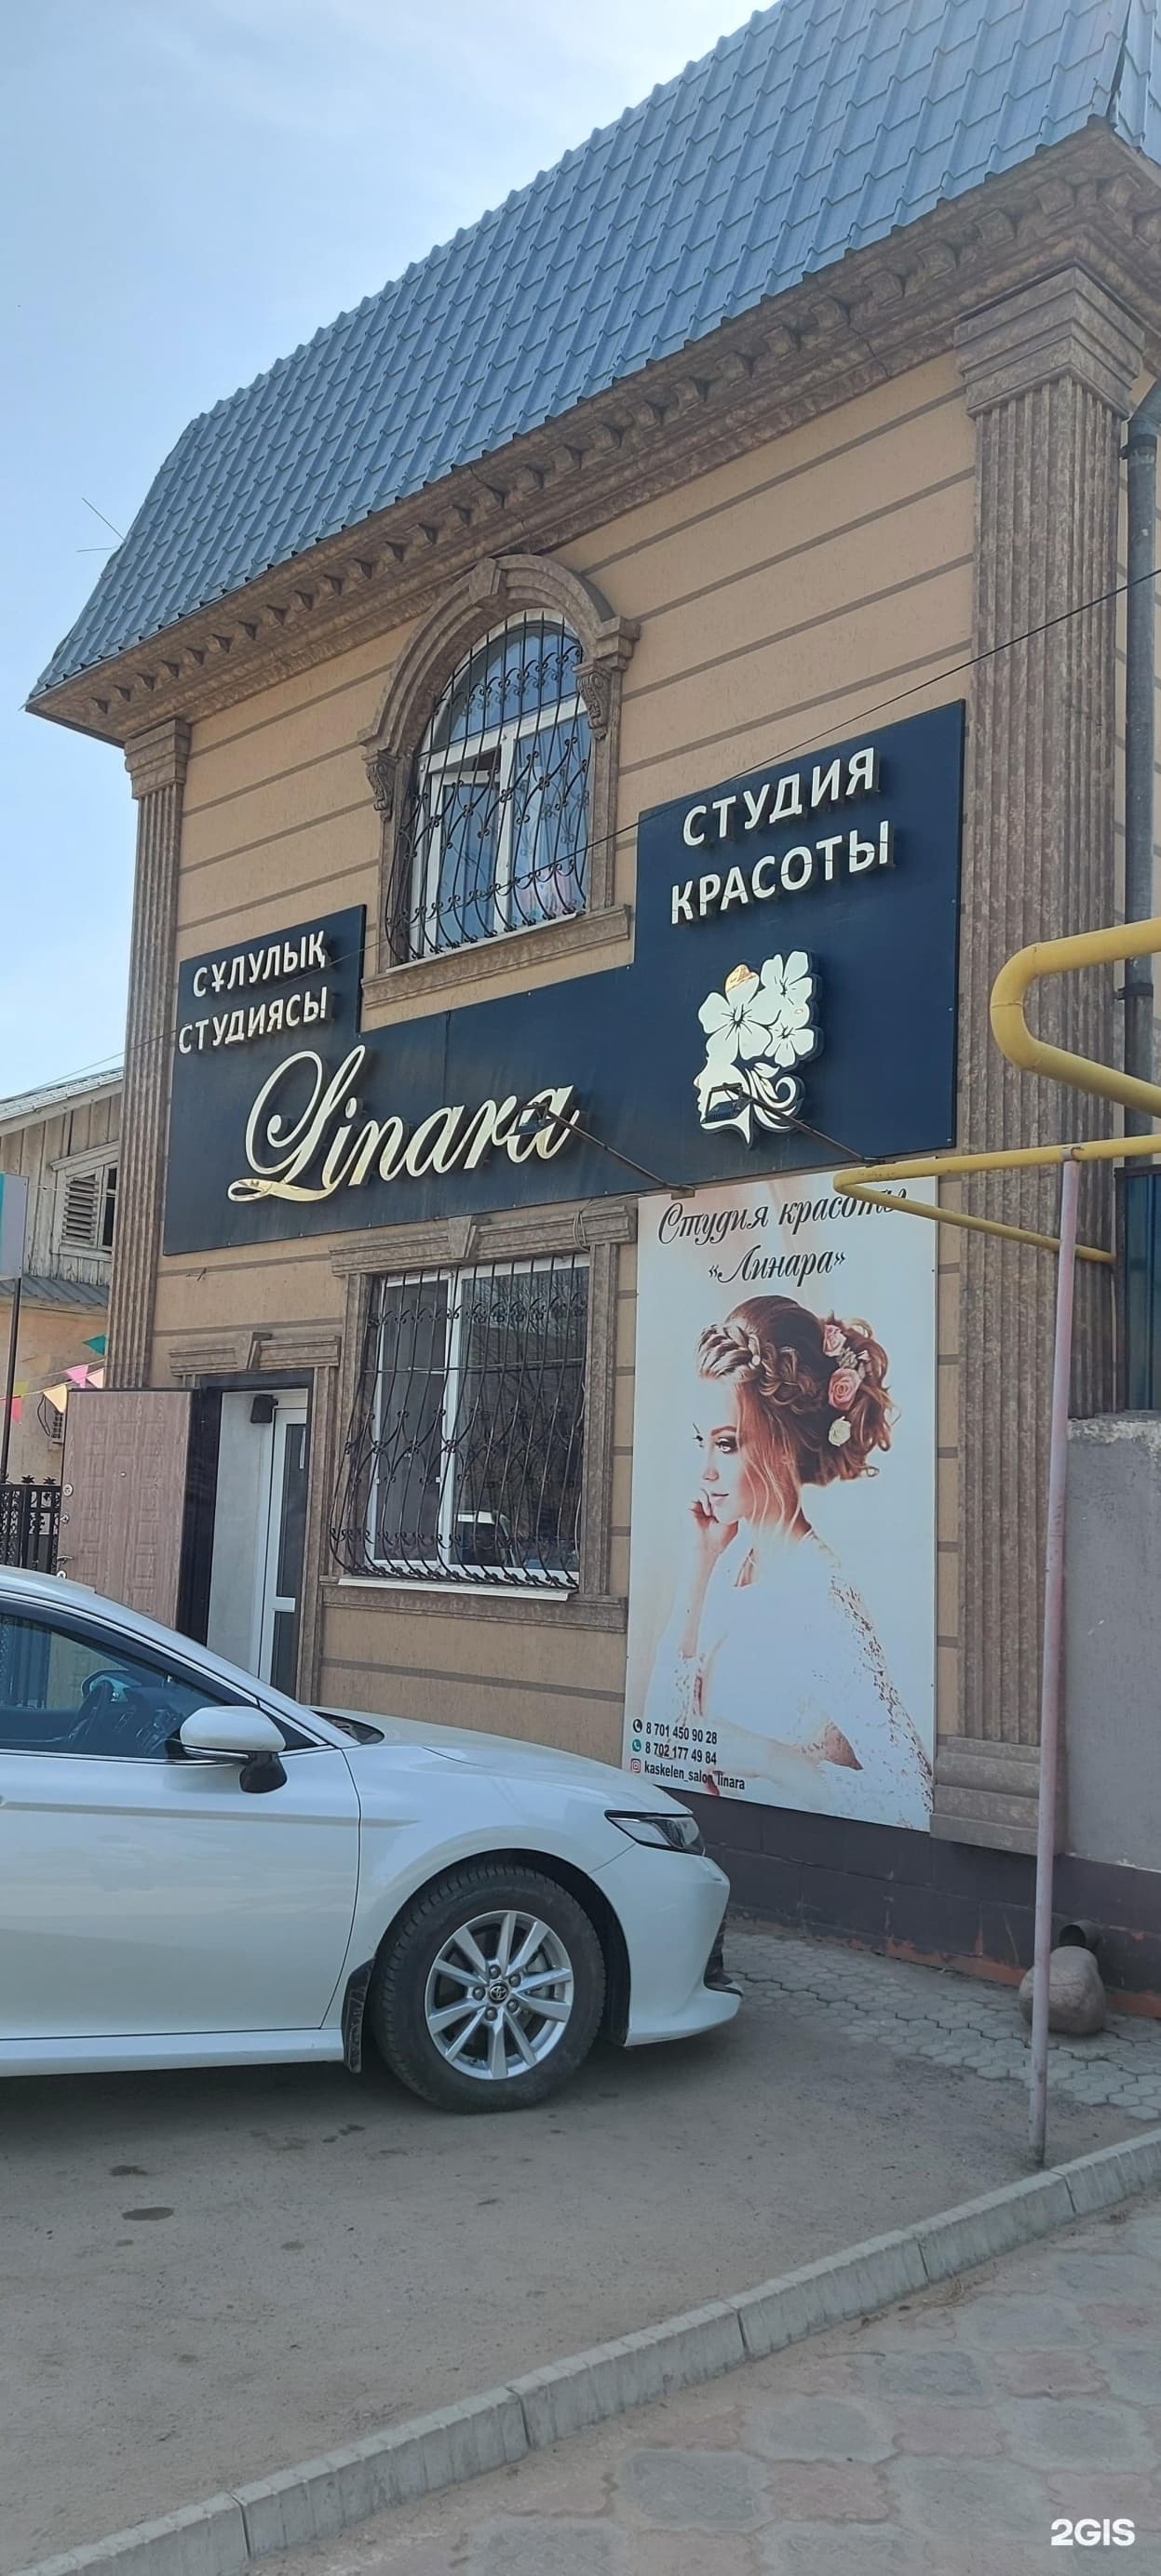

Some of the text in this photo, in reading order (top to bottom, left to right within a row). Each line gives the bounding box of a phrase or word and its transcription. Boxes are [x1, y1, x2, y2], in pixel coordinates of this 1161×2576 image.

[682, 747, 875, 846] СТУДИЯ
[671, 820, 889, 924] КРАСОТЫ
[193, 931, 327, 998] СҰЛУЛЫҚ
[178, 986, 327, 1053] СТУДИЯСЫ
[227, 1045, 580, 1202] Linara
[658, 1187, 908, 1245] Студия красот
[709, 1244, 845, 1287] «Линара»
[645, 1742, 717, 1765] 8 702 177 49 84
[646, 1722, 717, 1745] 8 701 450 90 28
